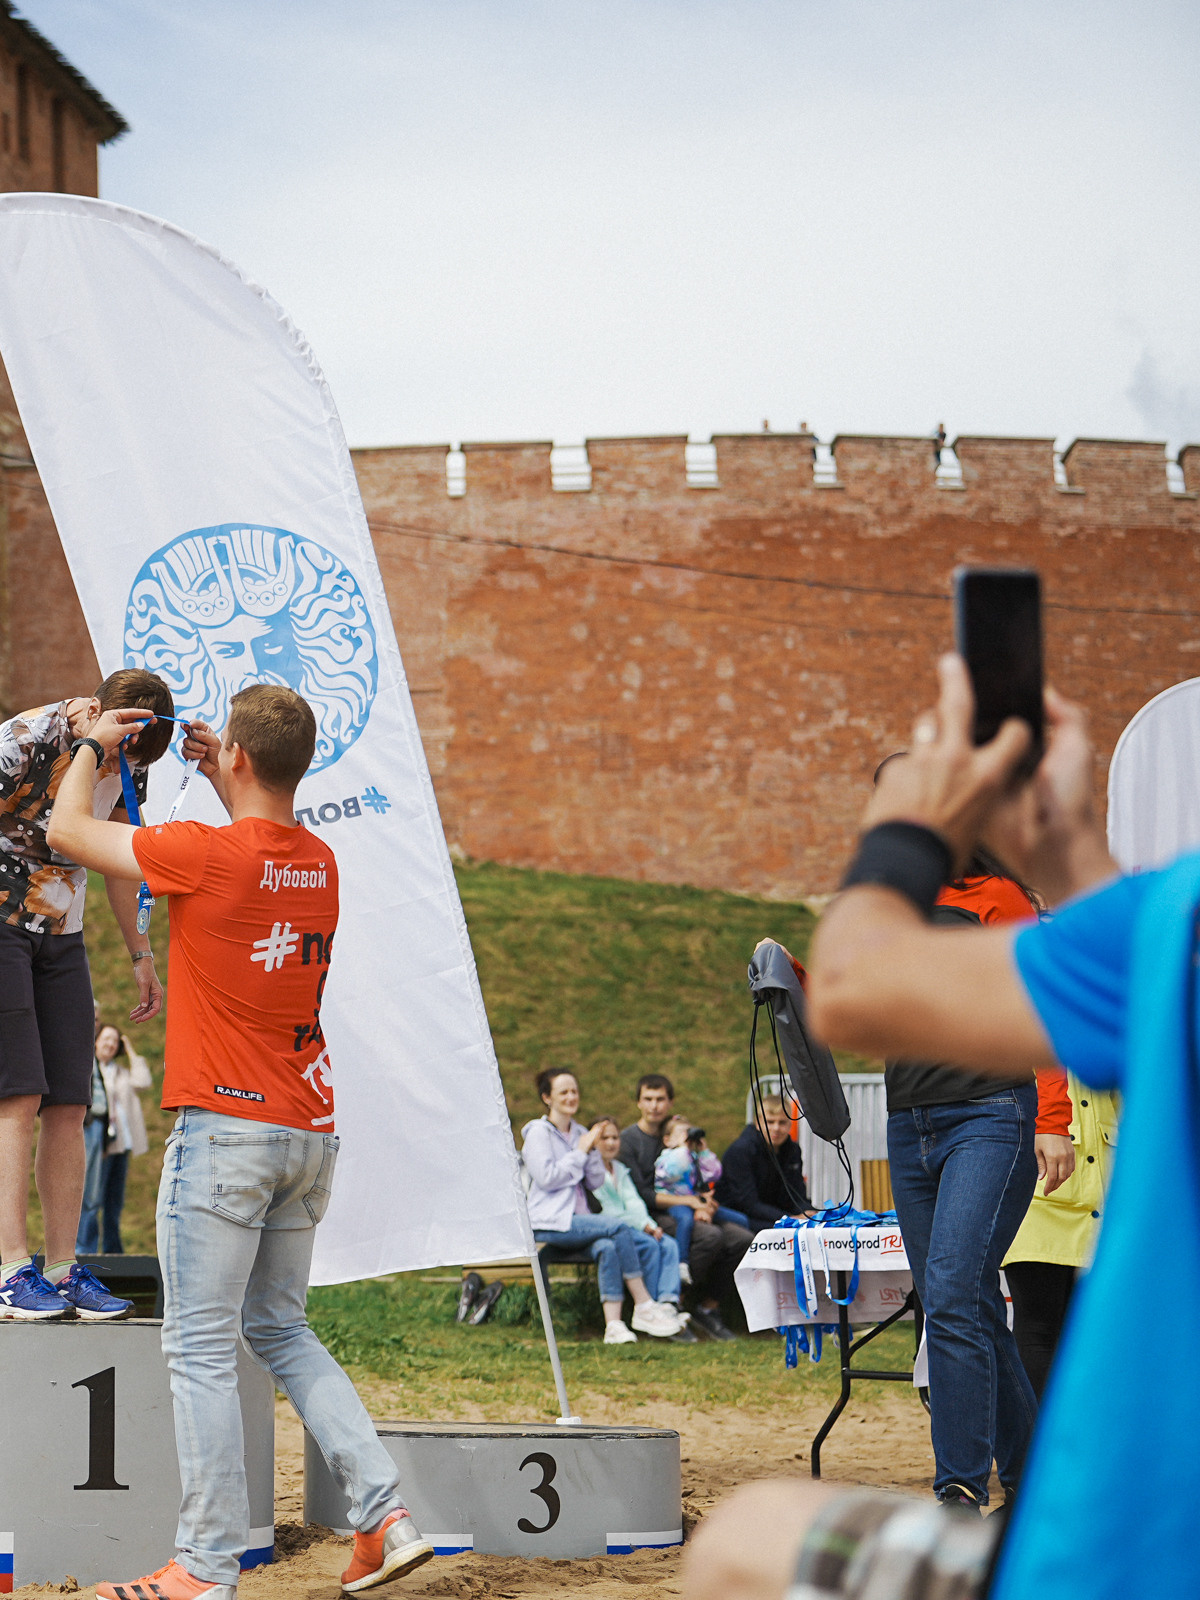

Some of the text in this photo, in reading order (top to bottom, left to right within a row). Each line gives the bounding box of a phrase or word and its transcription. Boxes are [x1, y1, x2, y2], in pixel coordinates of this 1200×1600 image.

[259, 860, 327, 893] Дубовой
[71, 1366, 130, 1490] 1
[517, 1452, 561, 1534] 3
